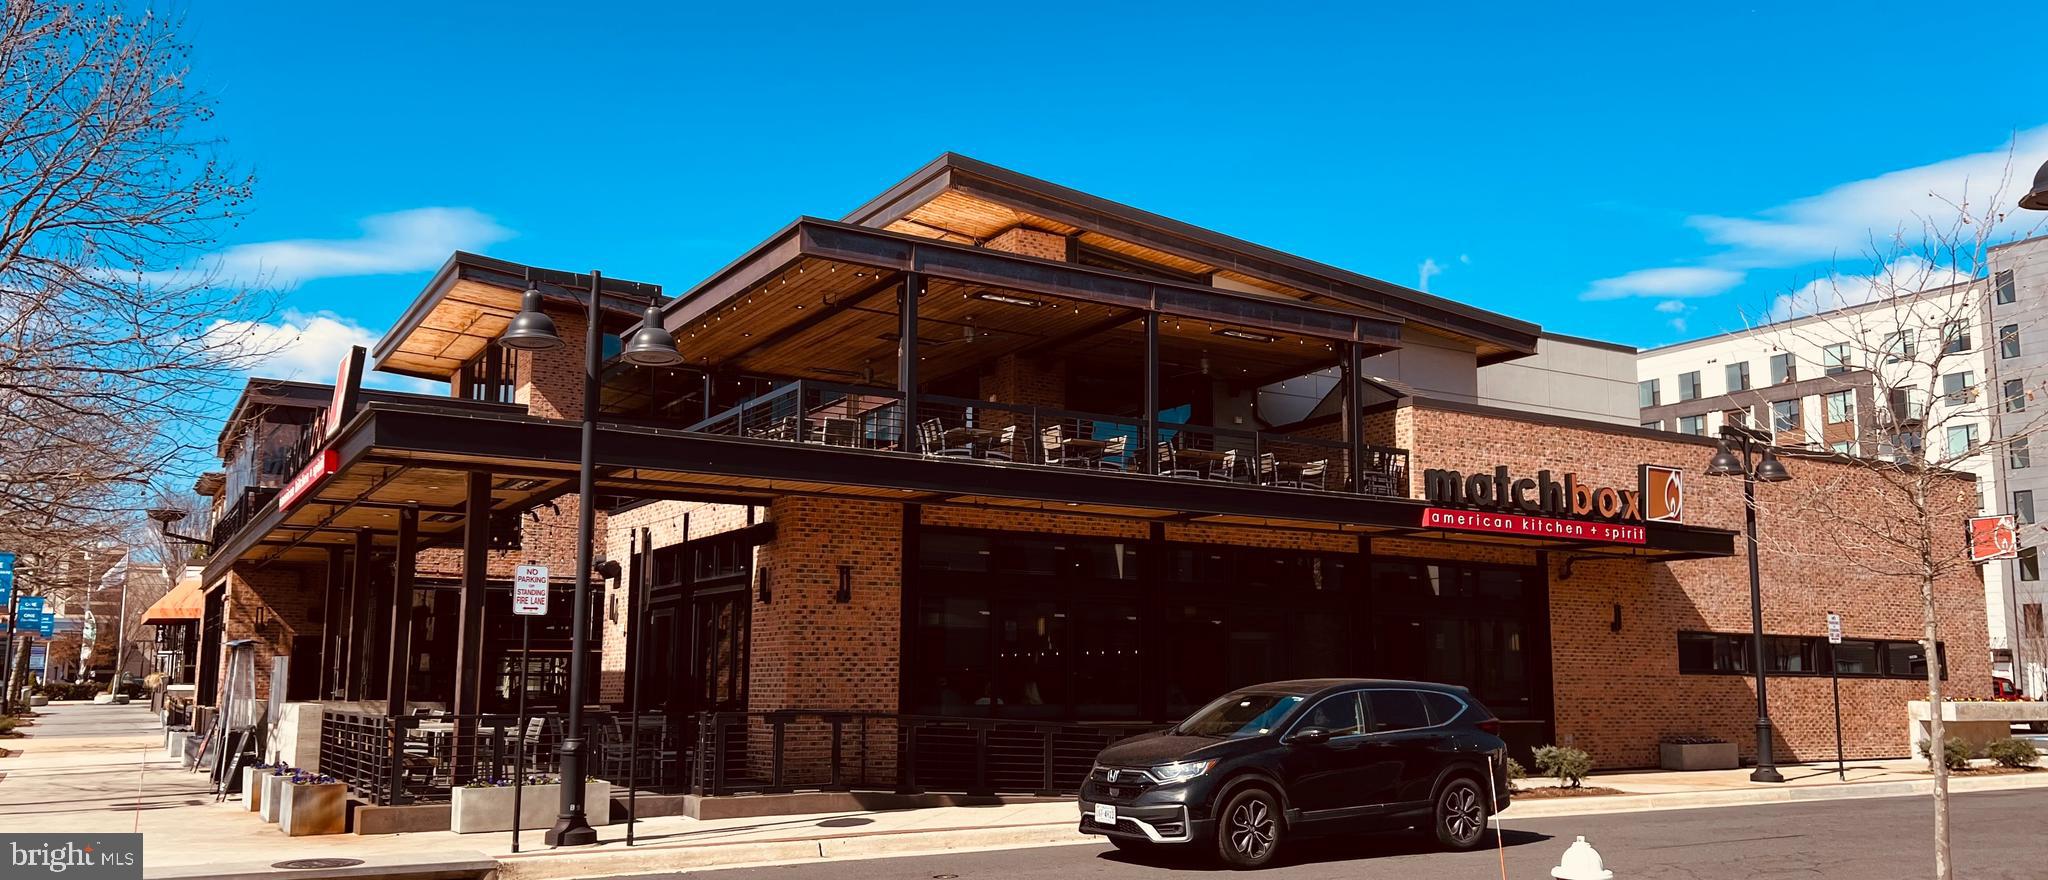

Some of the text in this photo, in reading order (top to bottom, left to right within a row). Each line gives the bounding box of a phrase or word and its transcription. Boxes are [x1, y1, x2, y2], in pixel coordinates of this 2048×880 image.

[1424, 466, 1642, 521] matchbox
[1431, 512, 1513, 529] american
[1522, 518, 1583, 535] kitchen
[1604, 528, 1645, 541] spirit
